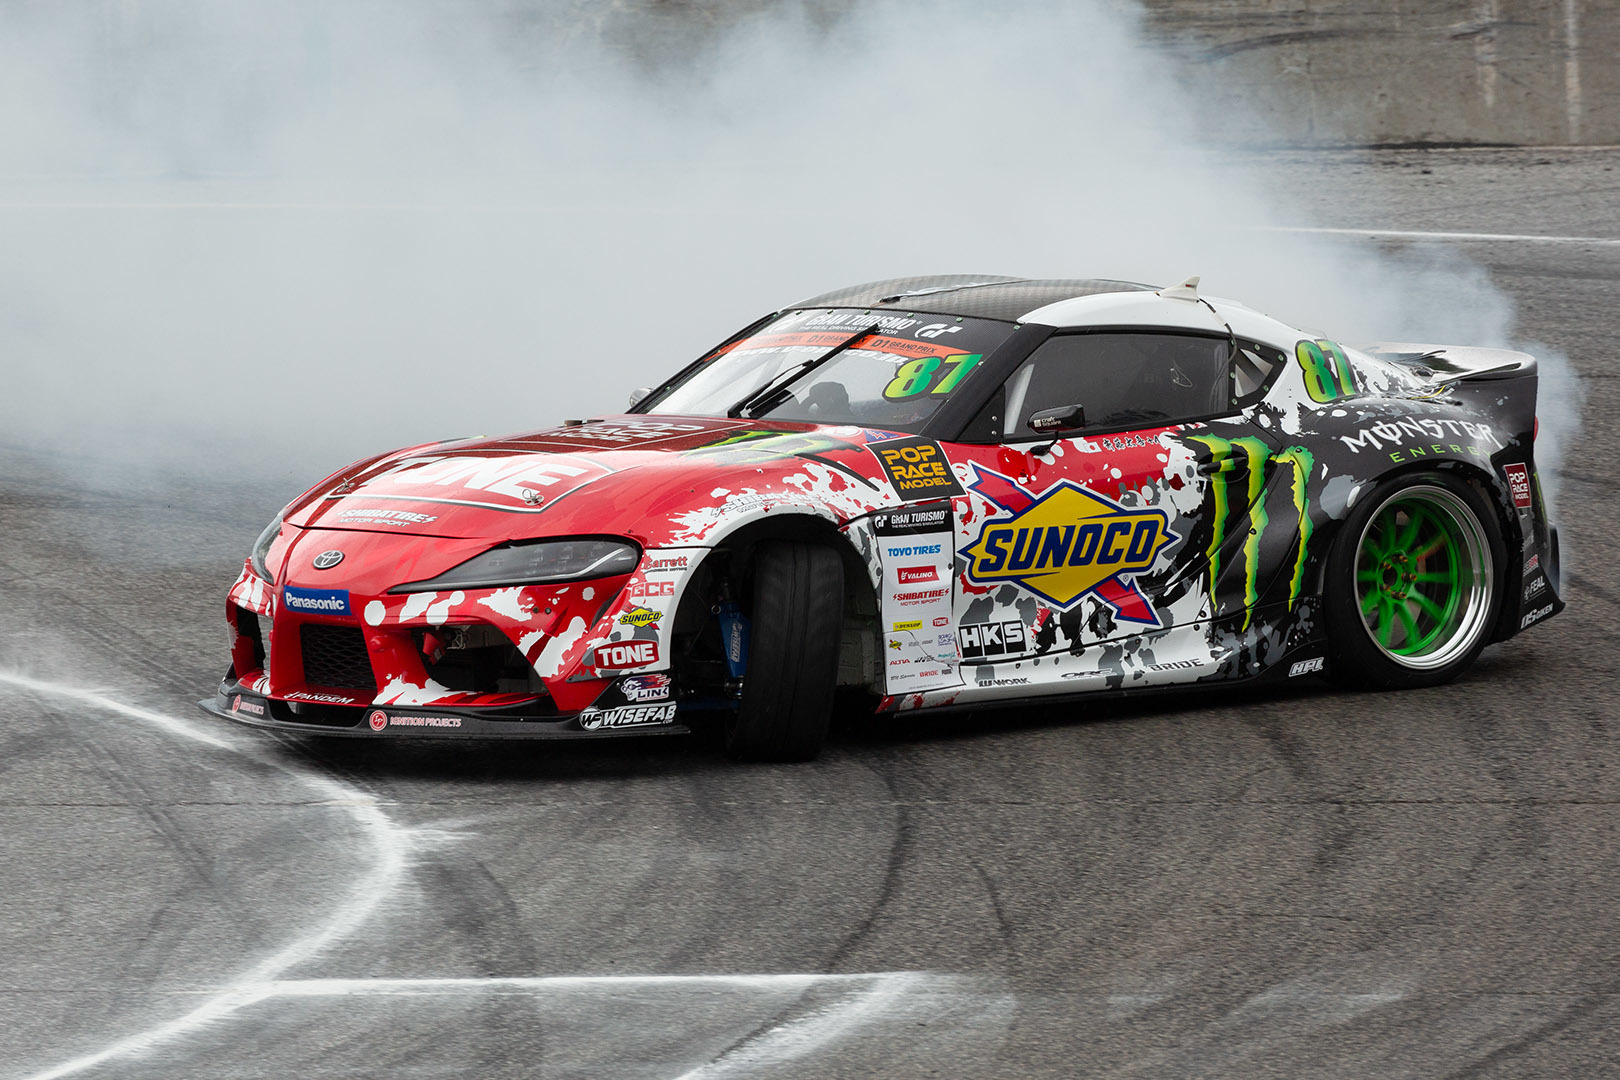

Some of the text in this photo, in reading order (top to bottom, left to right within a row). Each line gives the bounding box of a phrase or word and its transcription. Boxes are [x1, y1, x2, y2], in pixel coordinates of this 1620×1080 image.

[872, 339, 889, 348] D1
[889, 341, 915, 351] GRAND
[915, 344, 938, 354] PRIX
[884, 354, 984, 400] 87
[1296, 339, 1356, 404] 87
[881, 445, 936, 465] POP
[1389, 444, 1492, 464] ENERGY
[891, 462, 947, 480] RACE
[1509, 472, 1526, 484] POP
[900, 477, 952, 490] MODEL
[1512, 482, 1528, 493] RACE
[891, 514, 909, 525] GRAN
[911, 511, 945, 523] TURISMO
[888, 544, 941, 557] TOYO TIRES
[979, 520, 1160, 573] SUNOCO
[907, 571, 932, 579] VALINO
[631, 581, 674, 598] GCG
[285, 592, 345, 611] Panasonic
[622, 612, 660, 624] SUNOCO
[960, 621, 1027, 652] HKS
[598, 643, 656, 667] TONE
[1149, 658, 1205, 672] BRIDE
[390, 716, 424, 727] IGNITION
[425, 717, 461, 728] PROJECTS
[603, 705, 676, 726] WISEFAB
